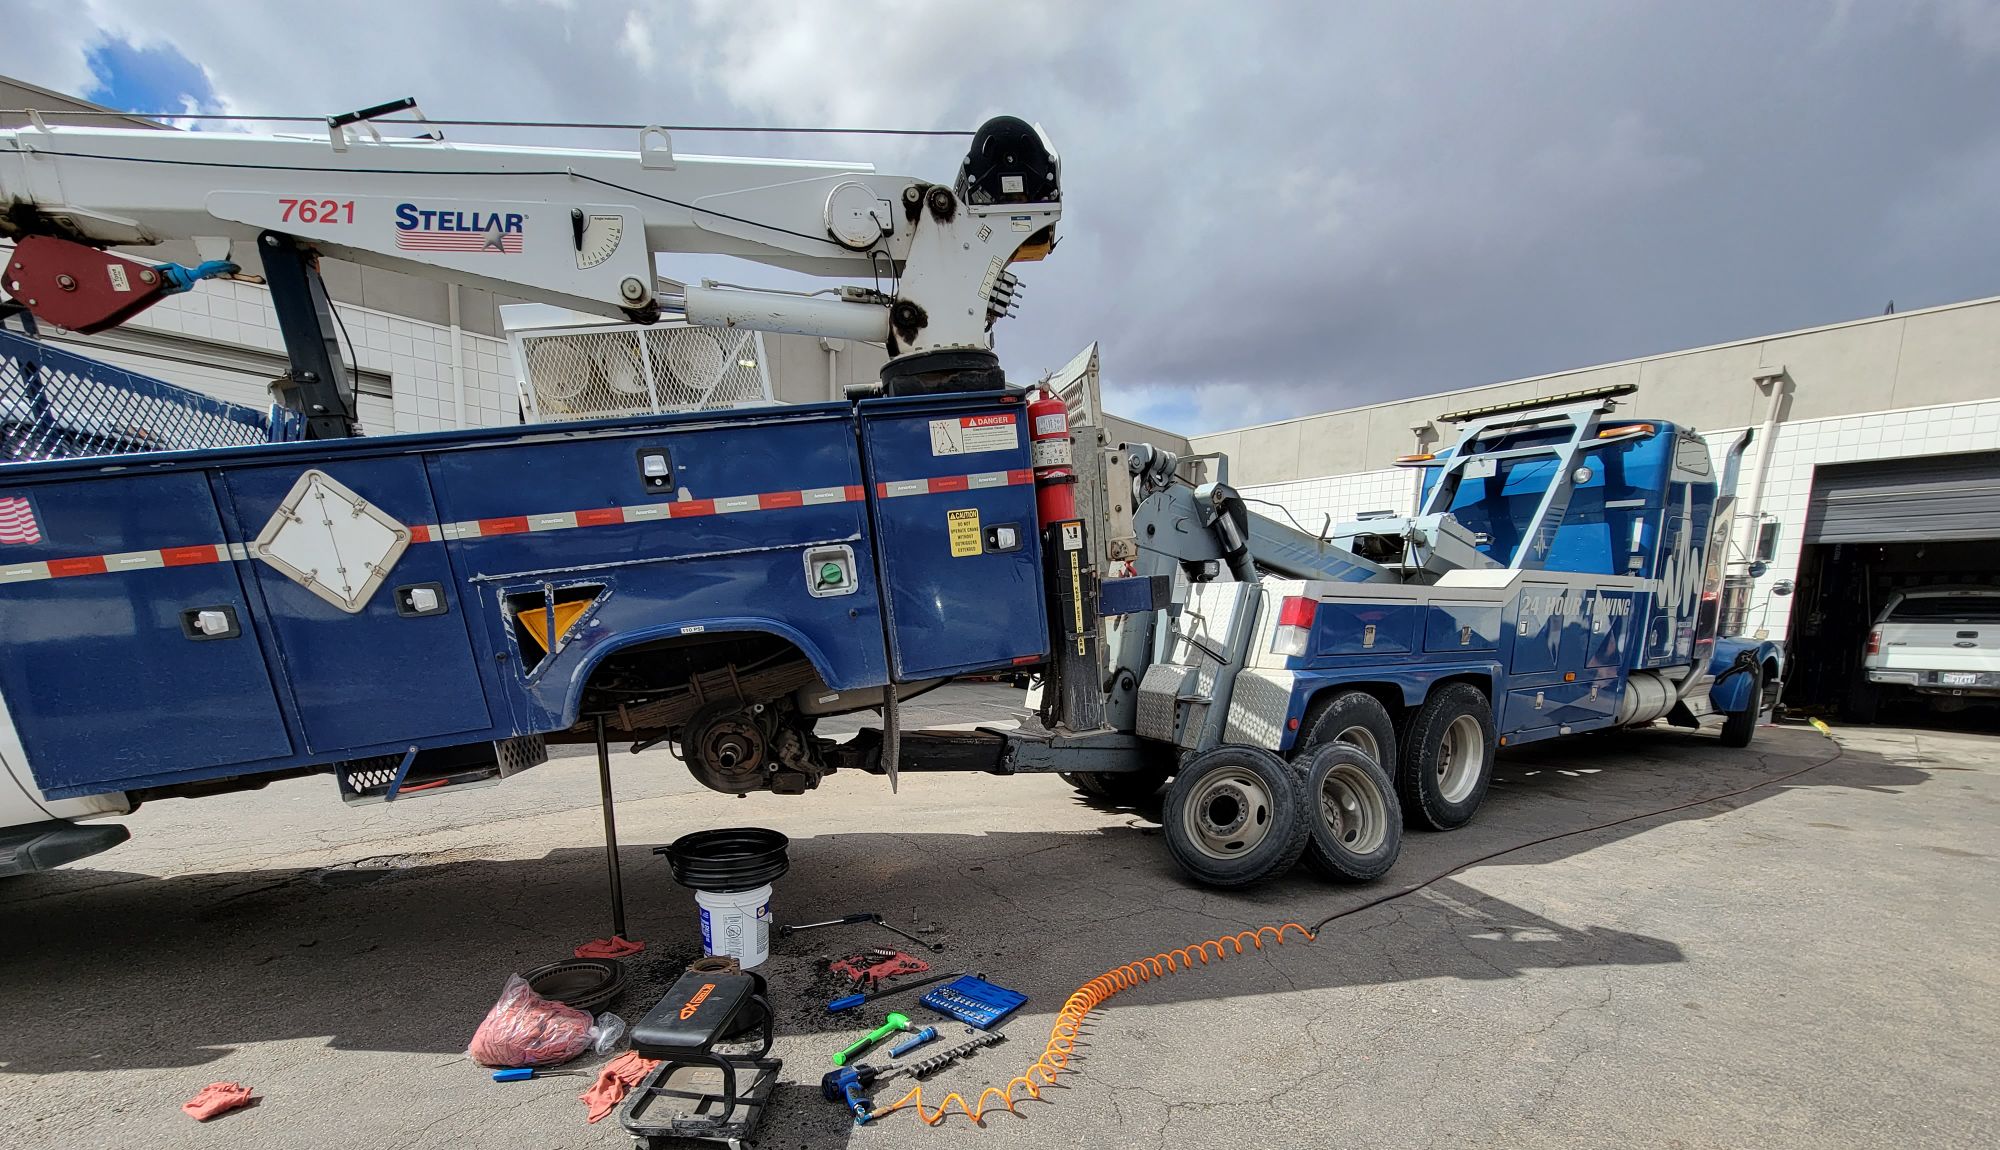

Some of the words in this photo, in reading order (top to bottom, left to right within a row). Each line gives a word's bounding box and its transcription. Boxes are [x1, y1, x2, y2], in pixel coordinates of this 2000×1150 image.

[279, 199, 354, 224] 7621
[396, 203, 523, 233] STELLAR
[978, 416, 1008, 426] DANGER
[956, 511, 977, 519] CAUTION
[1521, 596, 1540, 616] 24
[1545, 597, 1583, 616] HOUR
[1586, 598, 1631, 616] TWING
